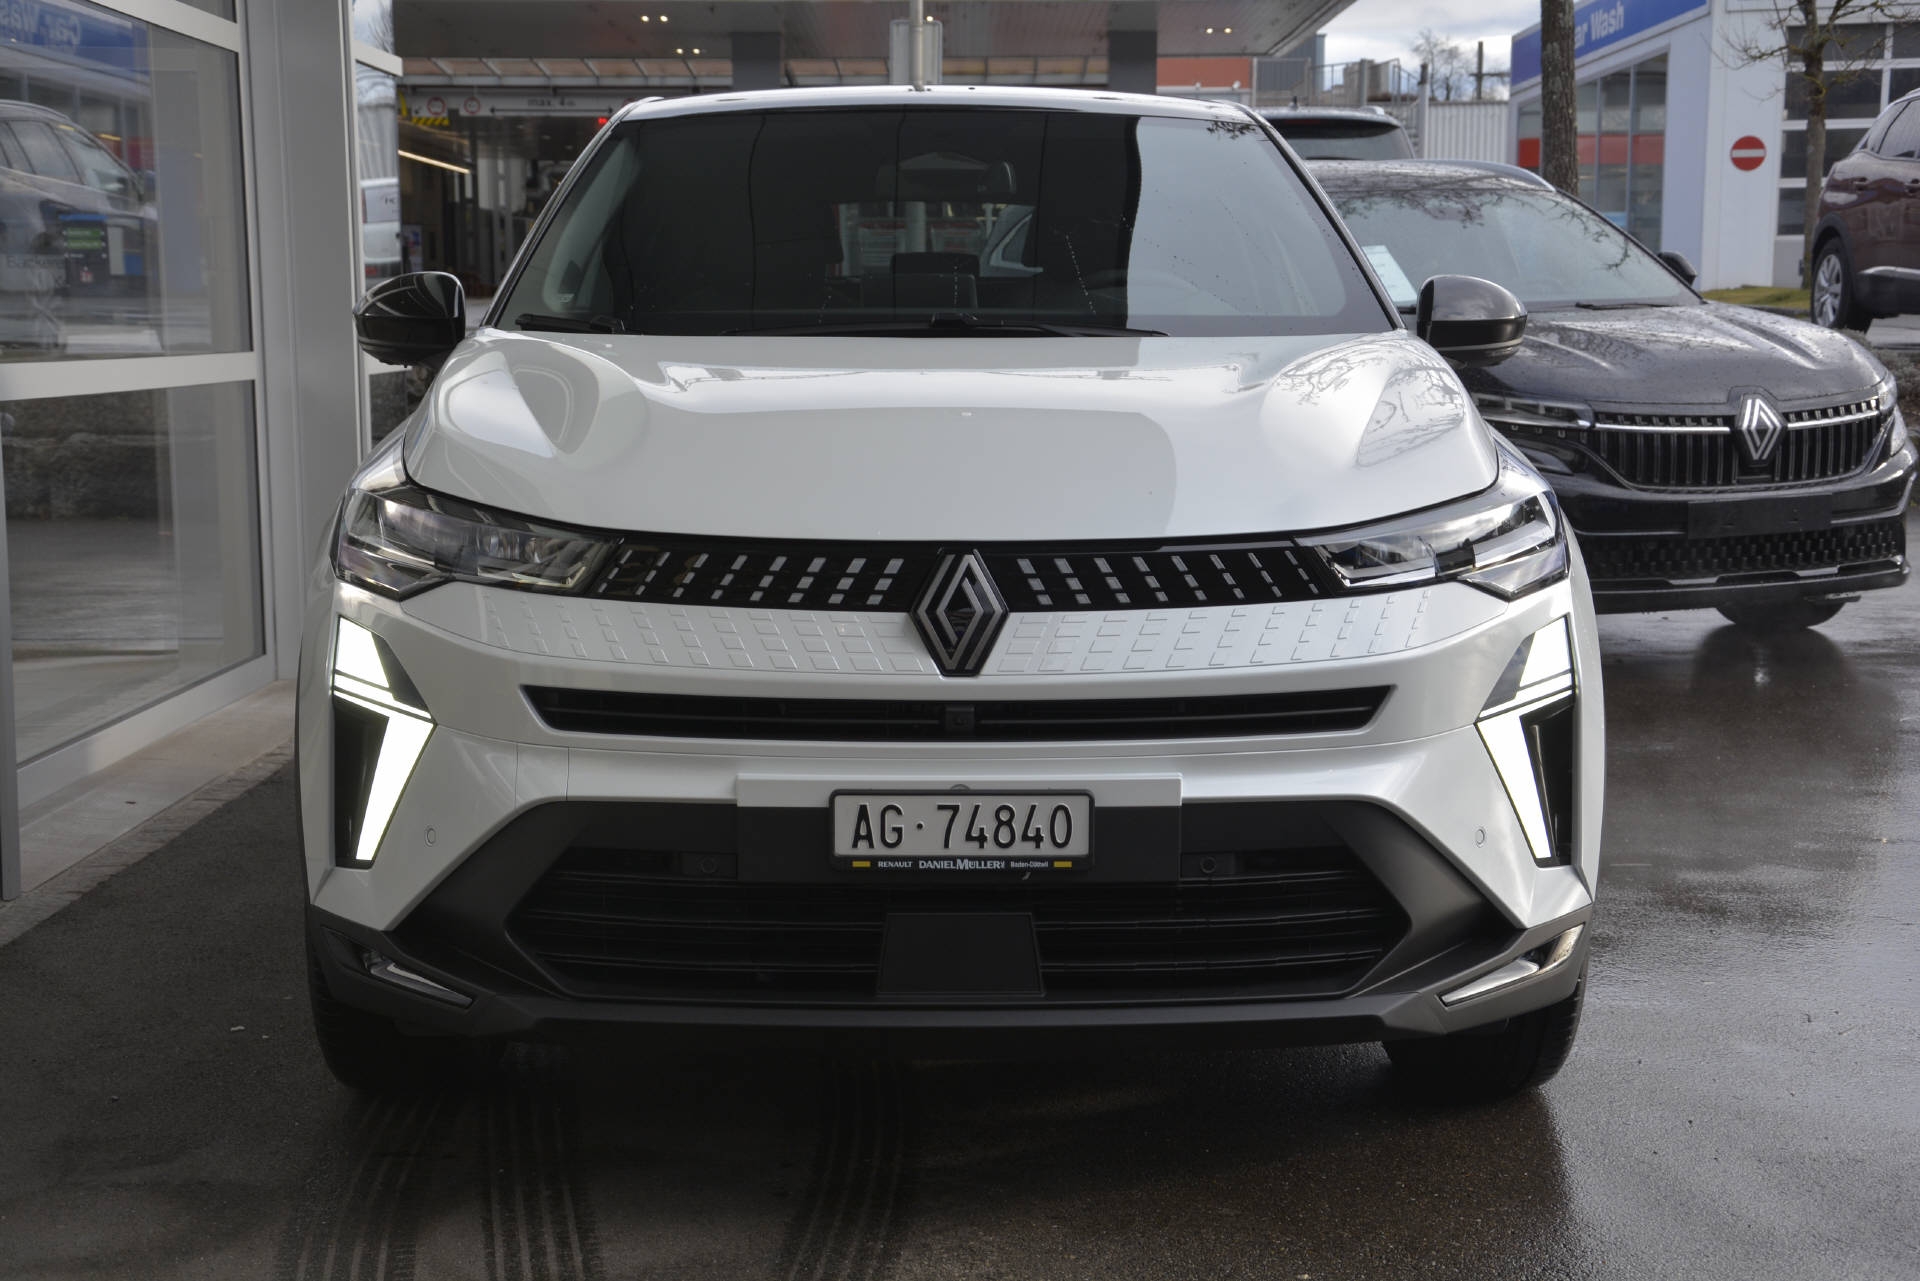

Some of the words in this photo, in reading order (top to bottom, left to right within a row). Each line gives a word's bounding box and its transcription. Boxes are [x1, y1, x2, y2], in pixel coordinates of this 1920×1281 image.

[1573, 20, 1588, 49] ar
[1591, 1, 1625, 41] Wash
[852, 803, 904, 849] AG
[937, 803, 1073, 849] 74840
[878, 860, 913, 868] RENAULT
